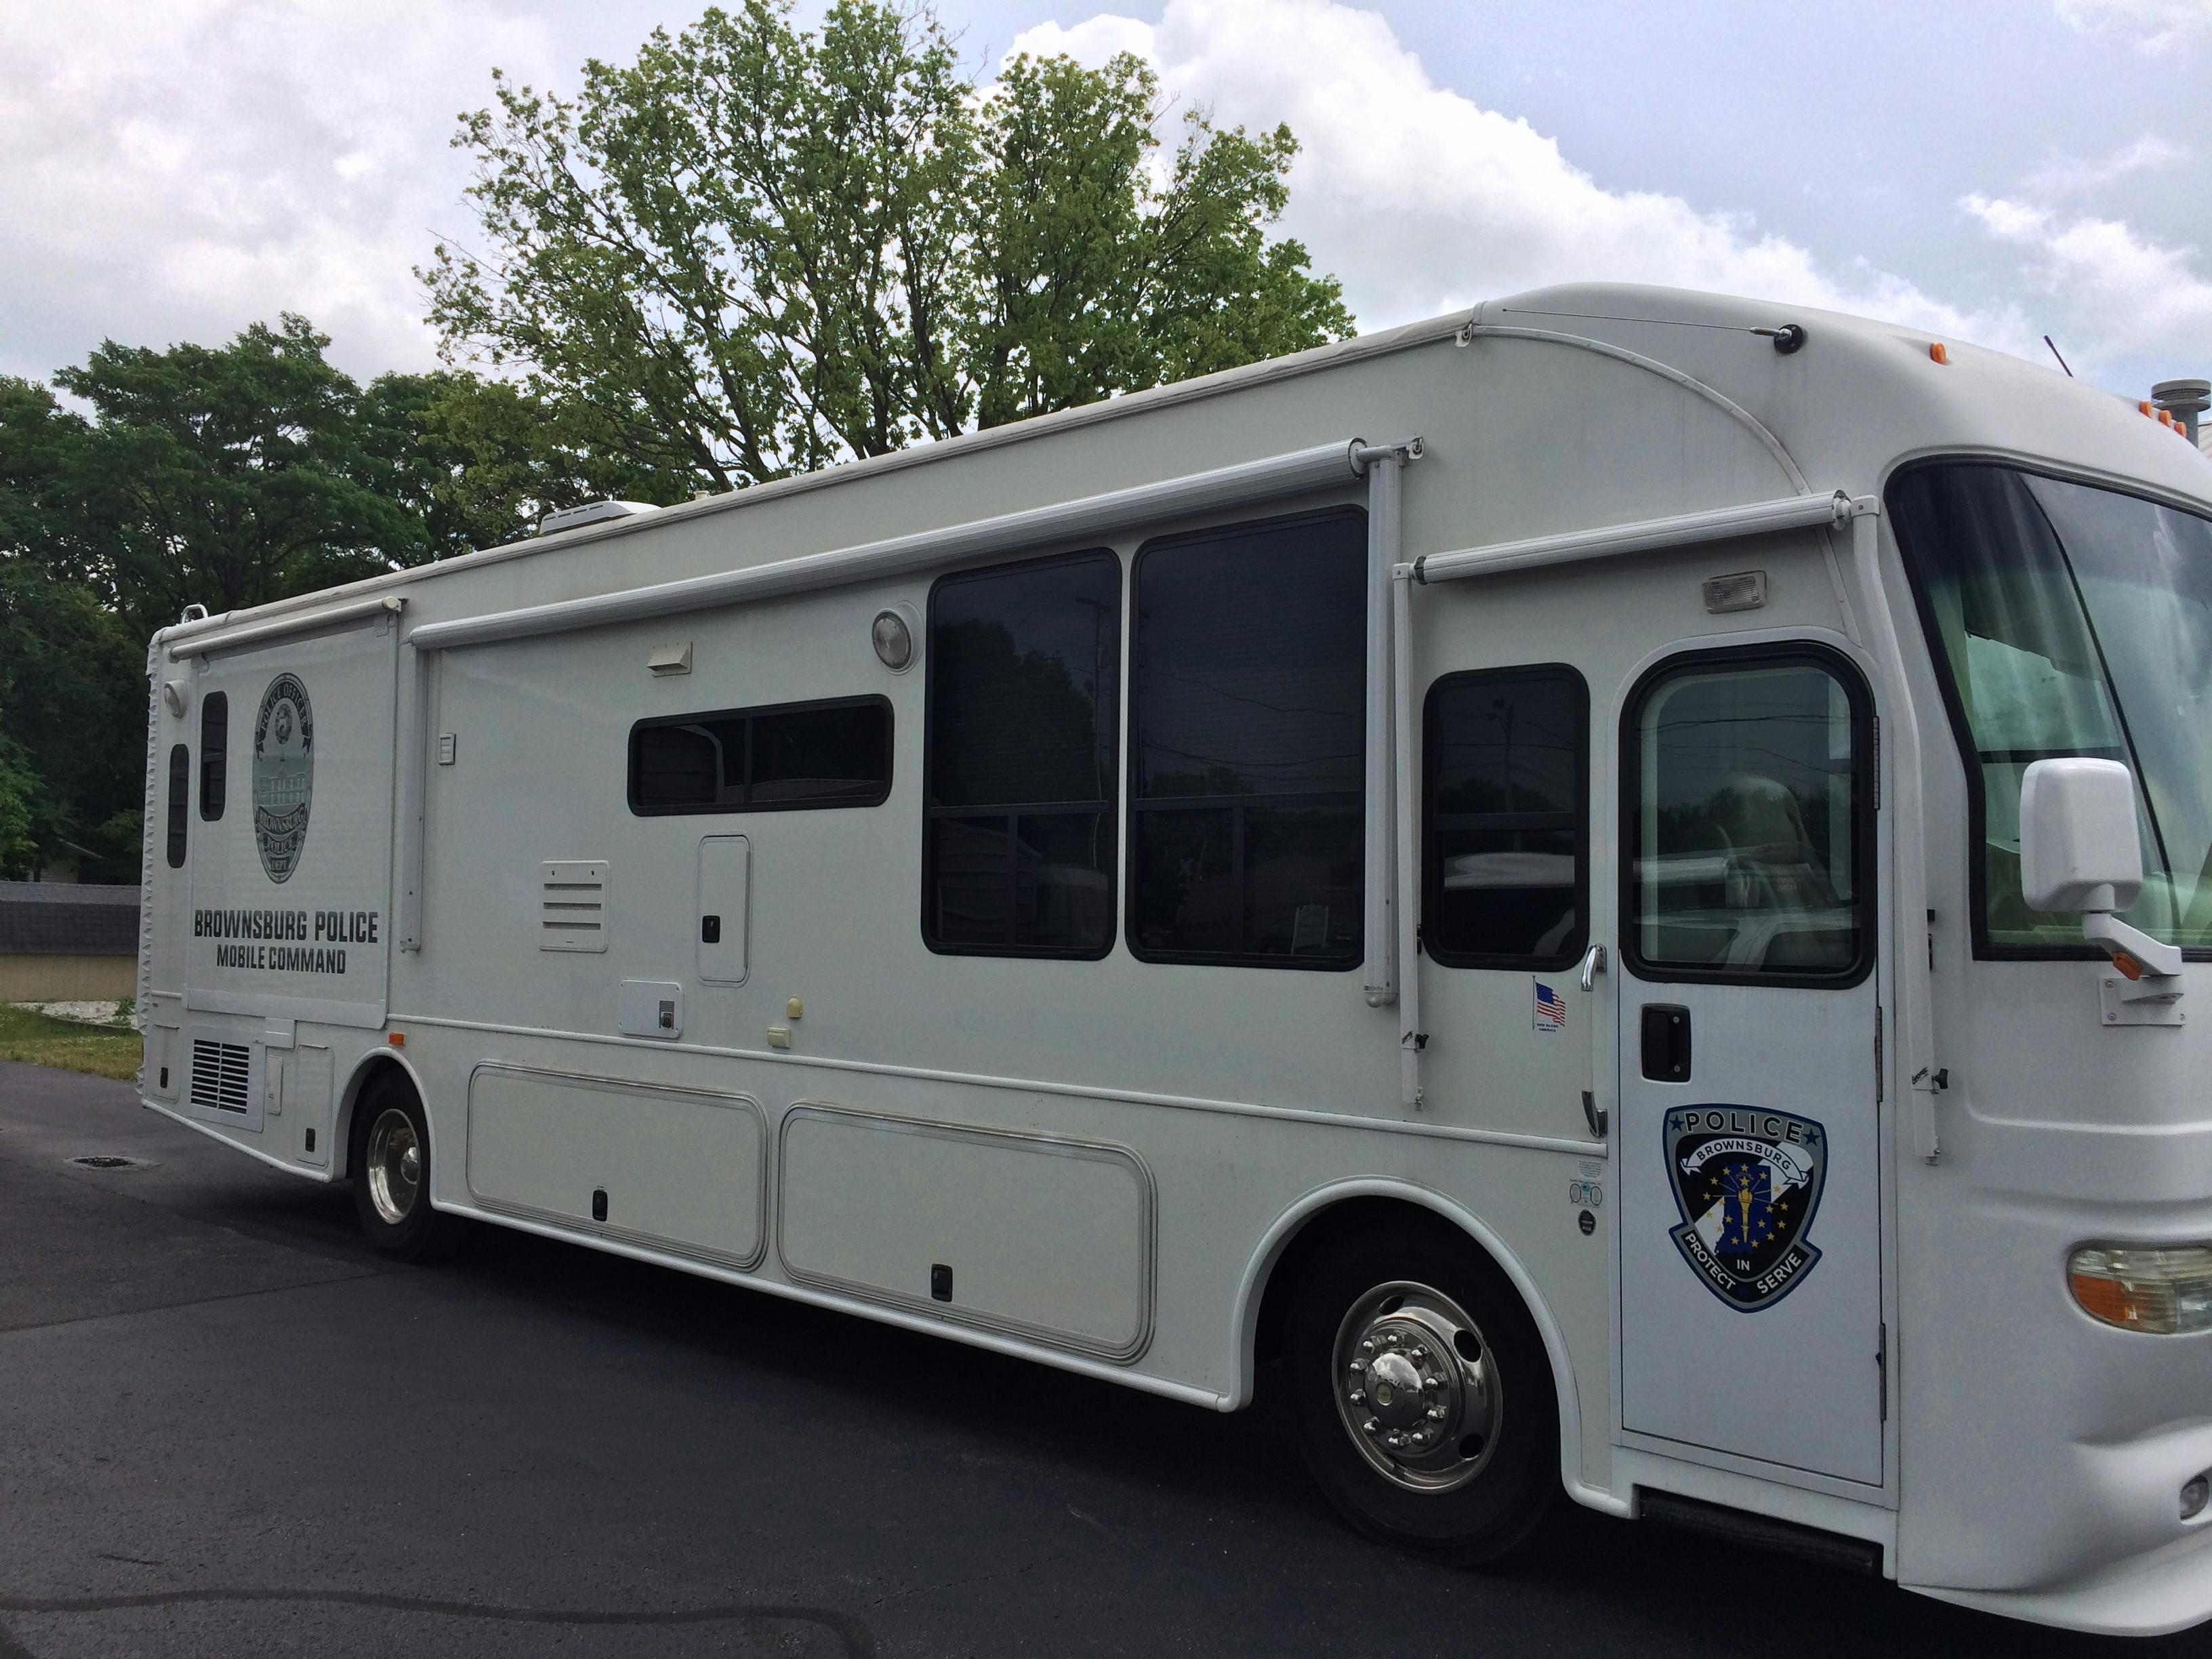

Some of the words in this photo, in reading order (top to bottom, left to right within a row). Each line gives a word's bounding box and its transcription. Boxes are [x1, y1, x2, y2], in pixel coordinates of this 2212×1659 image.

[261, 685, 281, 731] POLICE
[283, 683, 307, 726] OFFICER
[260, 807, 305, 832] BROWNSBURG
[268, 834, 293, 853] POLICE
[194, 909, 307, 941] BROWNSBURG
[315, 911, 378, 943] POLICE
[217, 944, 265, 969] MOBILE
[269, 946, 346, 974] COMMAND
[1684, 1111, 1804, 1144] POLICE
[1696, 1140, 1791, 1170] BROWNSBURG
[1685, 1233, 1736, 1290] PROTECT
[1757, 1252, 1802, 1294] SERVE
[1736, 1258, 1750, 1271] IN
